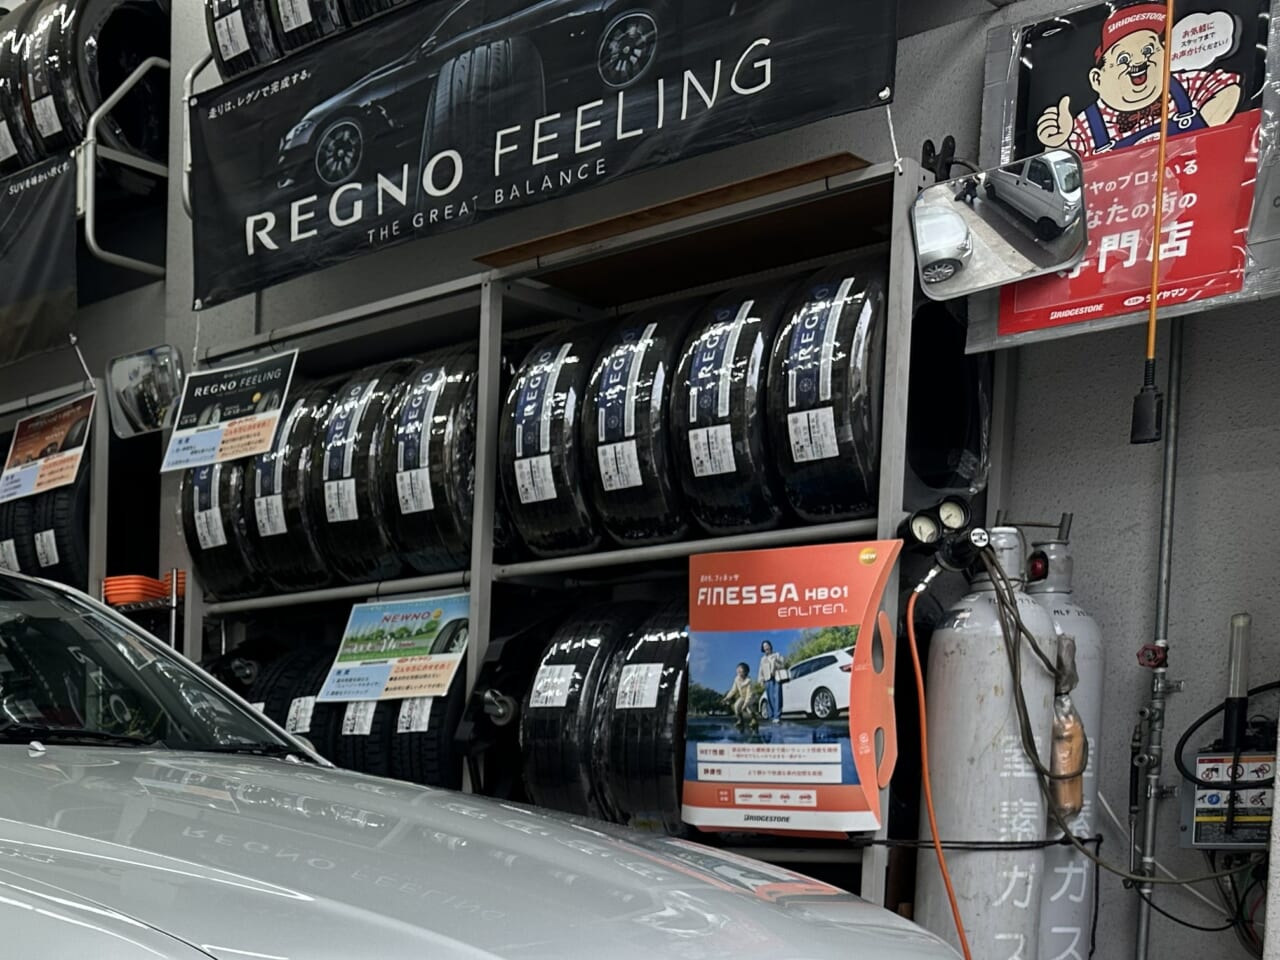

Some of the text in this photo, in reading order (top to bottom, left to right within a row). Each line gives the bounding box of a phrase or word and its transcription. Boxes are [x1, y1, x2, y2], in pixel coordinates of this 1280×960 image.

[1108, 12, 1166, 33] BRIDGESTONE
[245, 38, 771, 256] REGNO FEELING
[368, 158, 607, 244] THE GREAT BALANCE
[1050, 304, 1104, 319] BRIDGESTONE
[194, 381, 237, 397] REGNO
[239, 368, 282, 387] FEELING
[697, 582, 849, 606] FINESSA HB01
[382, 611, 431, 623] NEWNO
[744, 814, 790, 823] BRIDGESTONE
